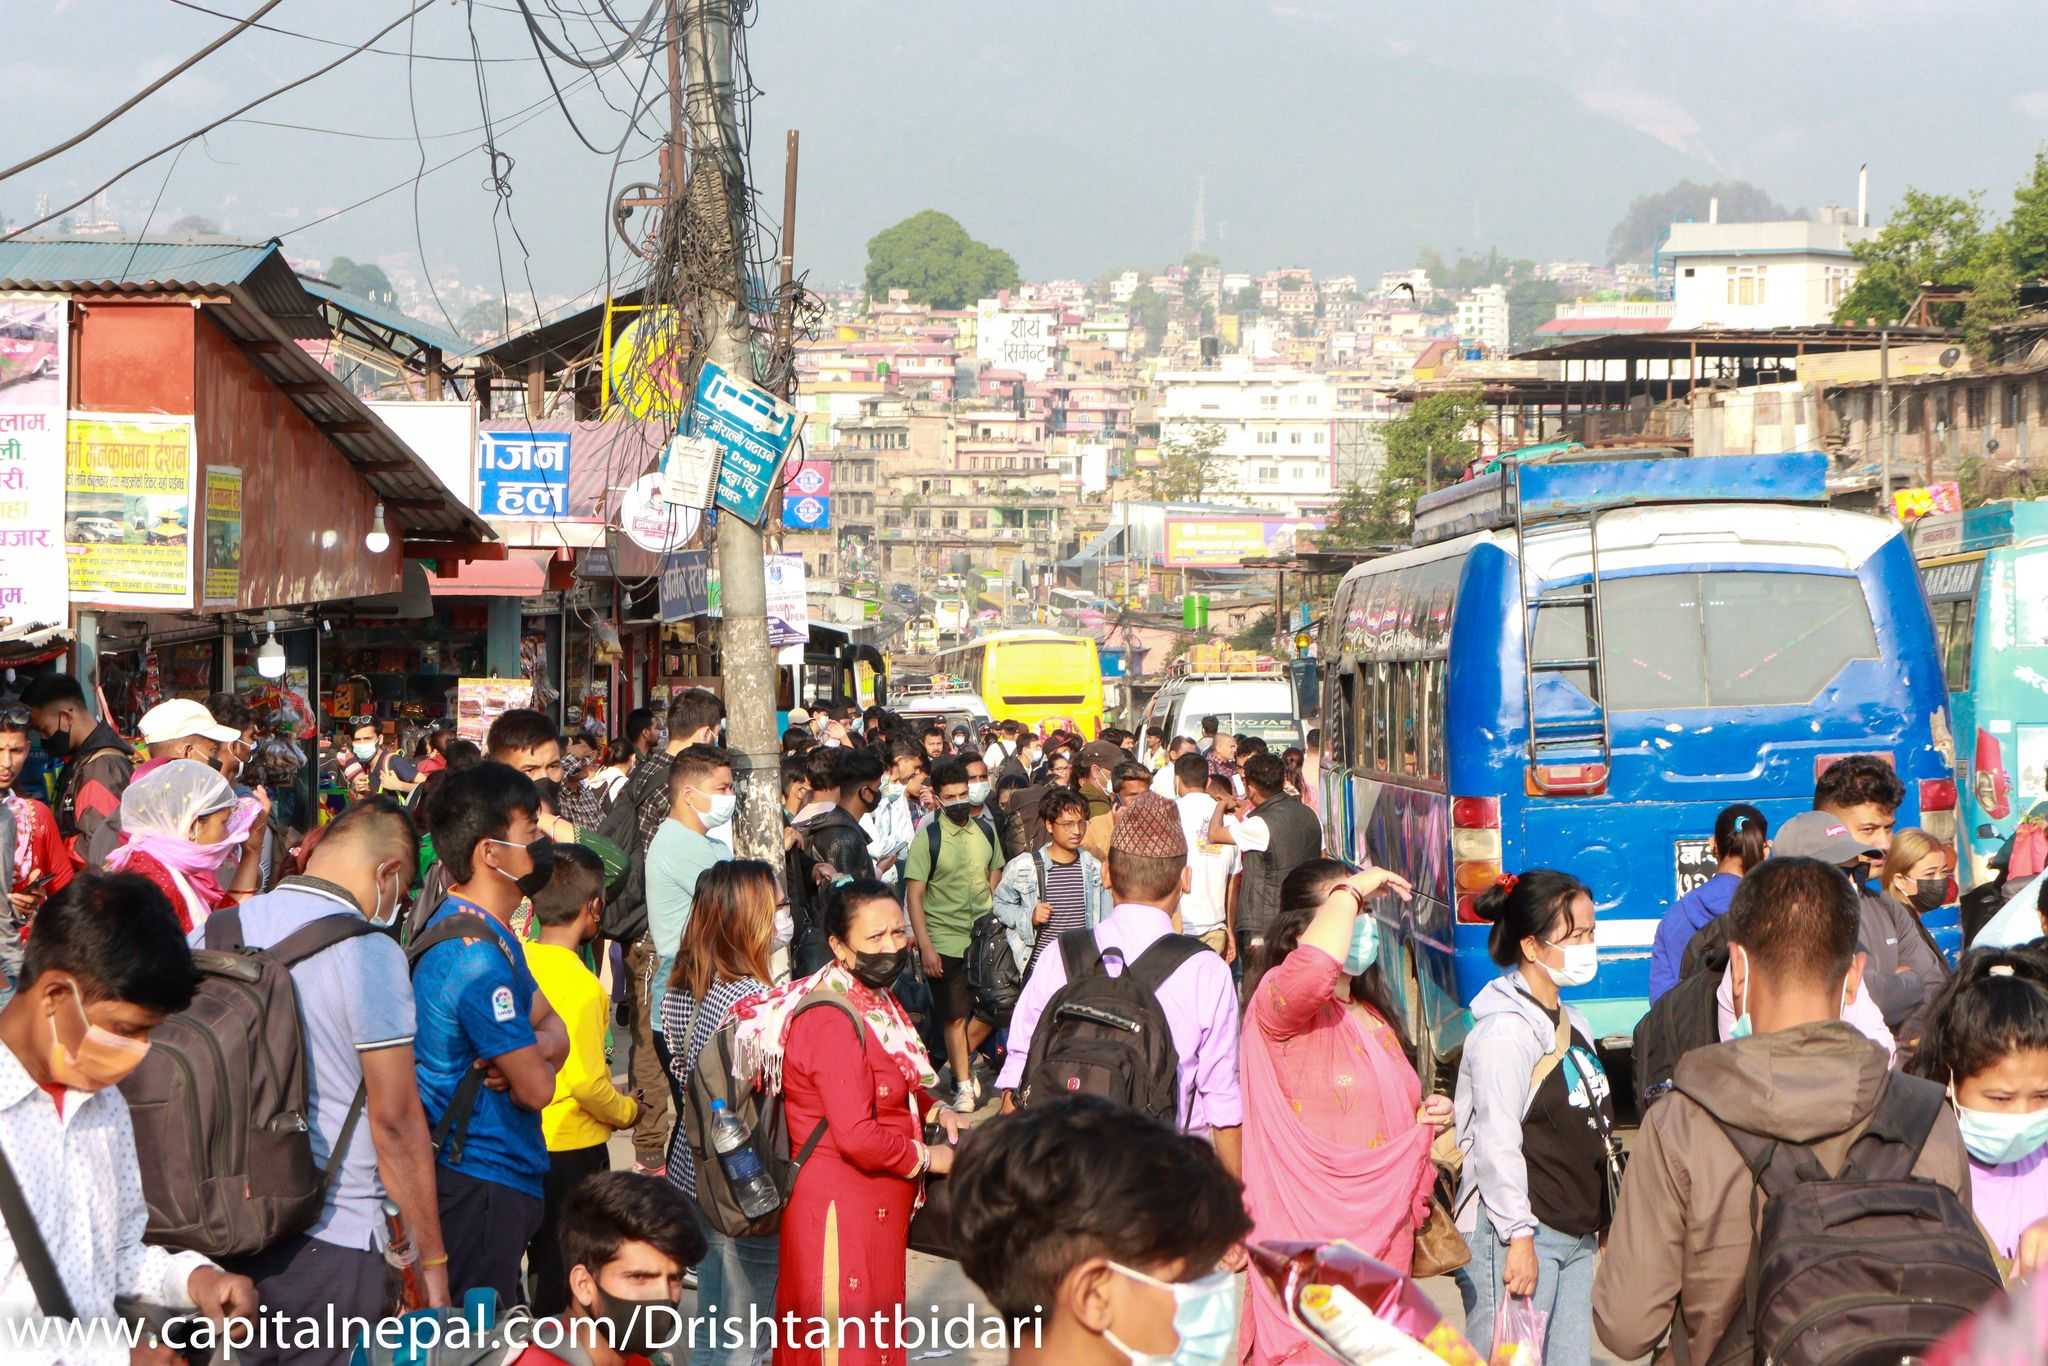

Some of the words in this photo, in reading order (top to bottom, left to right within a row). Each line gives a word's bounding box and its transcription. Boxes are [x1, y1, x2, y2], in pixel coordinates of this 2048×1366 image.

[479, 431, 568, 471] ोजन
[730, 450, 761, 475] Drop)
[496, 481, 567, 515] हल
